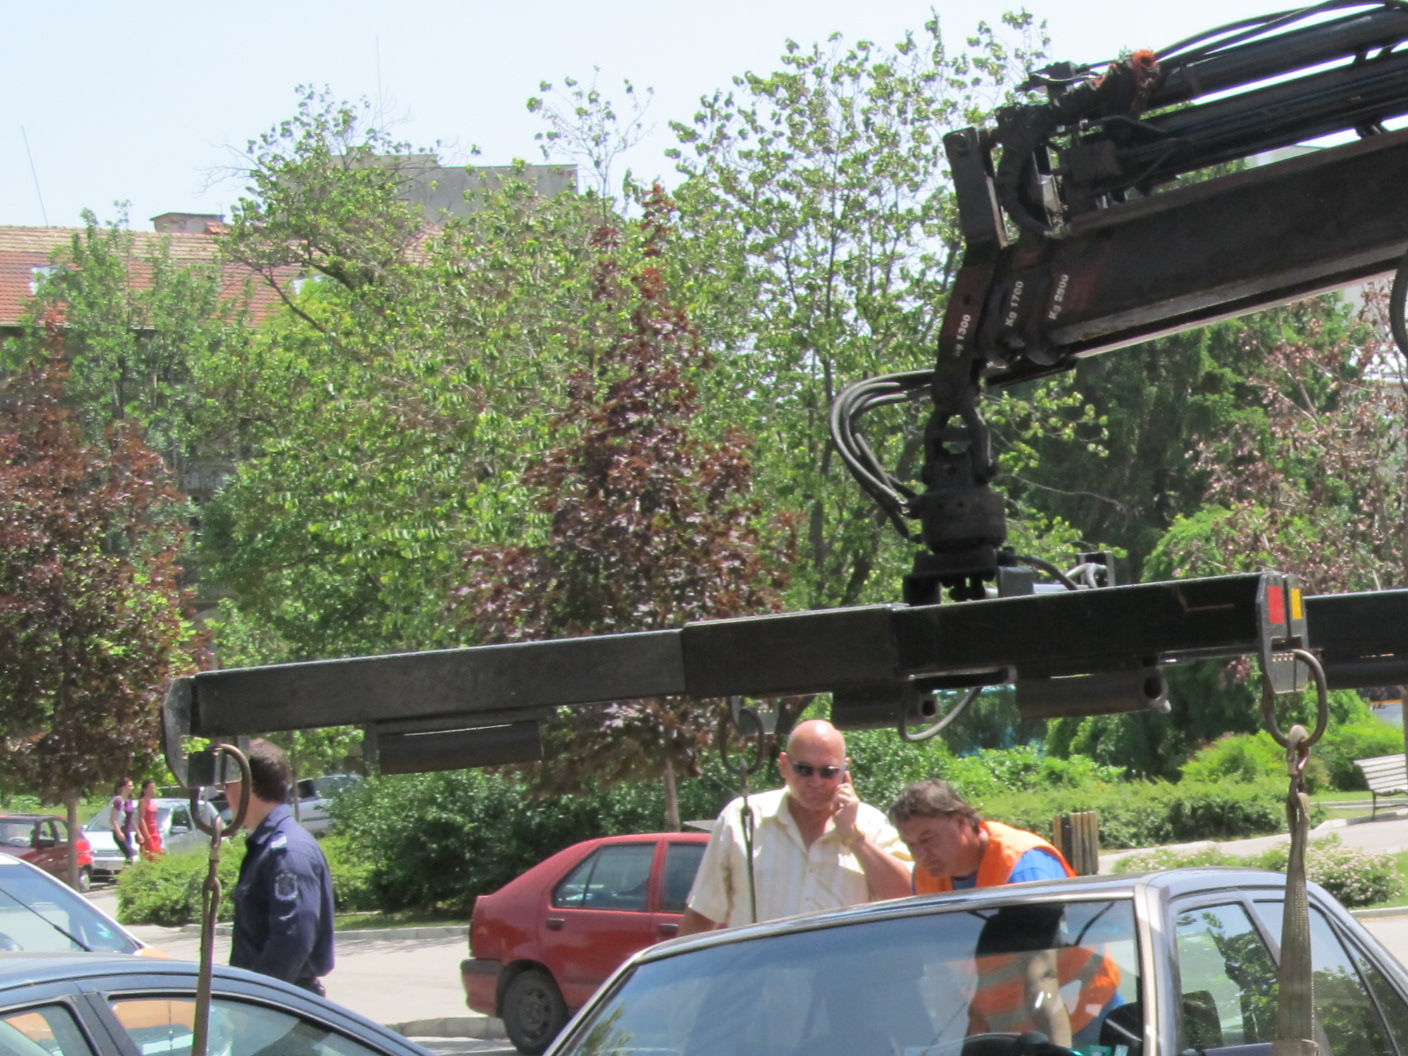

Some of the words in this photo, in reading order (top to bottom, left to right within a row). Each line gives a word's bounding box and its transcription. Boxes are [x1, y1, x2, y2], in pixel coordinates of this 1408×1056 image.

[1010, 280, 1025, 308] 1700
[1054, 273, 1069, 303] 2500
[956, 313, 972, 341] 1300
[1004, 311, 1018, 327] Kg
